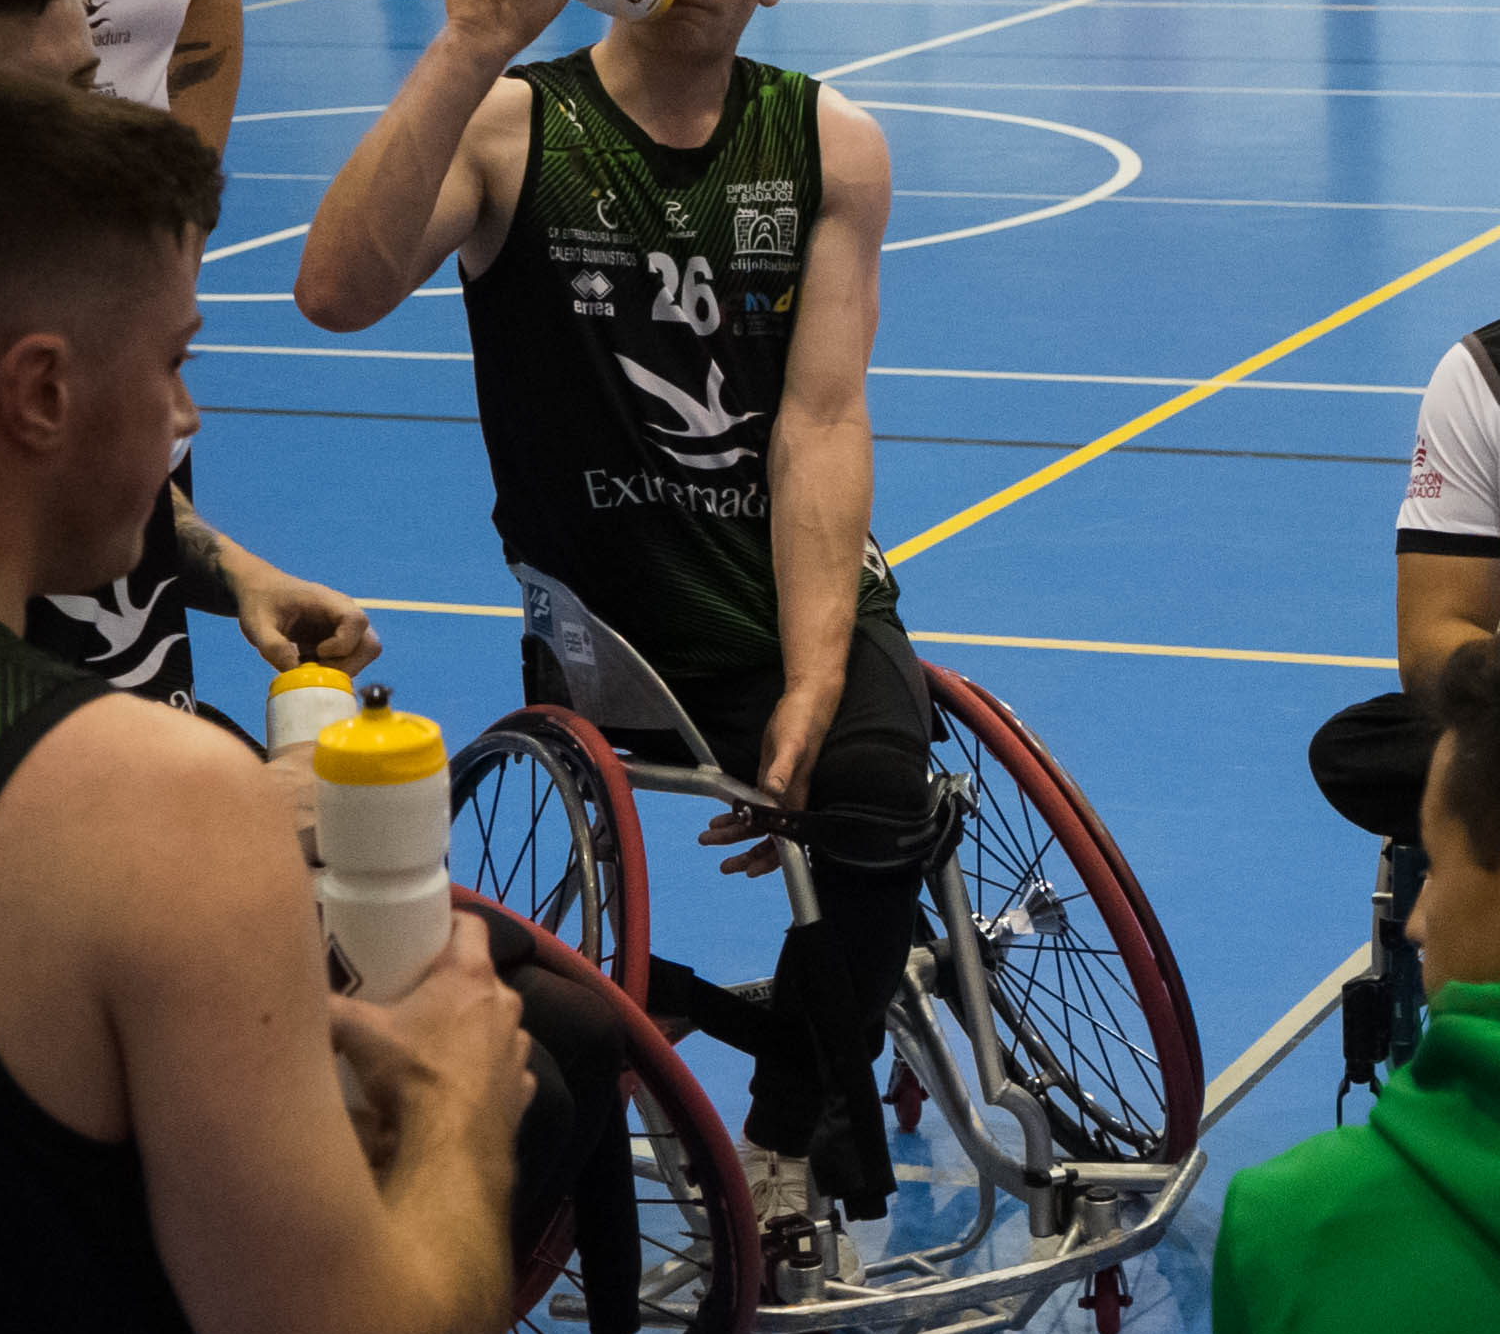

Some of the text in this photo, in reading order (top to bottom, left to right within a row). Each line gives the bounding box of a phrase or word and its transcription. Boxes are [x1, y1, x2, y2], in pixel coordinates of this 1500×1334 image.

[92, 29, 132, 47] adura
[741, 190, 793, 202] BADAJOZ
[550, 246, 637, 266] CALERO SUMINISTROS
[647, 251, 721, 336] 26
[573, 299, 615, 317] errea
[1411, 471, 1443, 486] ACIÓN
[584, 468, 767, 519] Extremad
